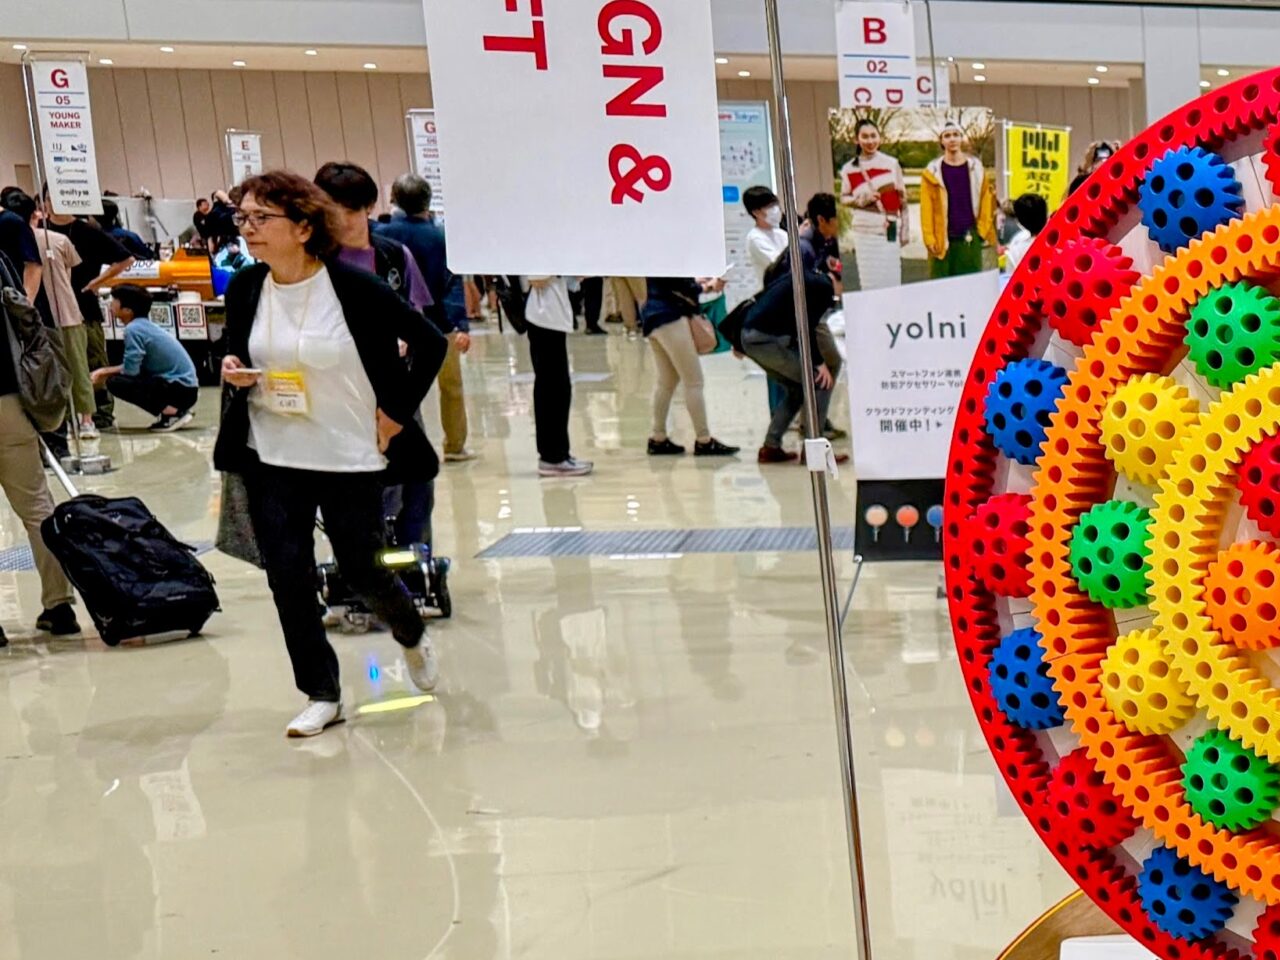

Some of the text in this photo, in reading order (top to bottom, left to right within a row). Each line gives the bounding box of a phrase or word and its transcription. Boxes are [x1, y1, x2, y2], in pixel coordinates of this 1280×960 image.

[863, 17, 887, 44] B
[866, 60, 888, 73] 02
[51, 69, 69, 89] G
[916, 75, 932, 94] C
[55, 95, 71, 105] 05
[49, 112, 81, 120] YOUNG
[50, 121, 82, 129] MAKER
[241, 140, 250, 151] E
[608, 143, 672, 205] &
[886, 311, 966, 349] yolni
